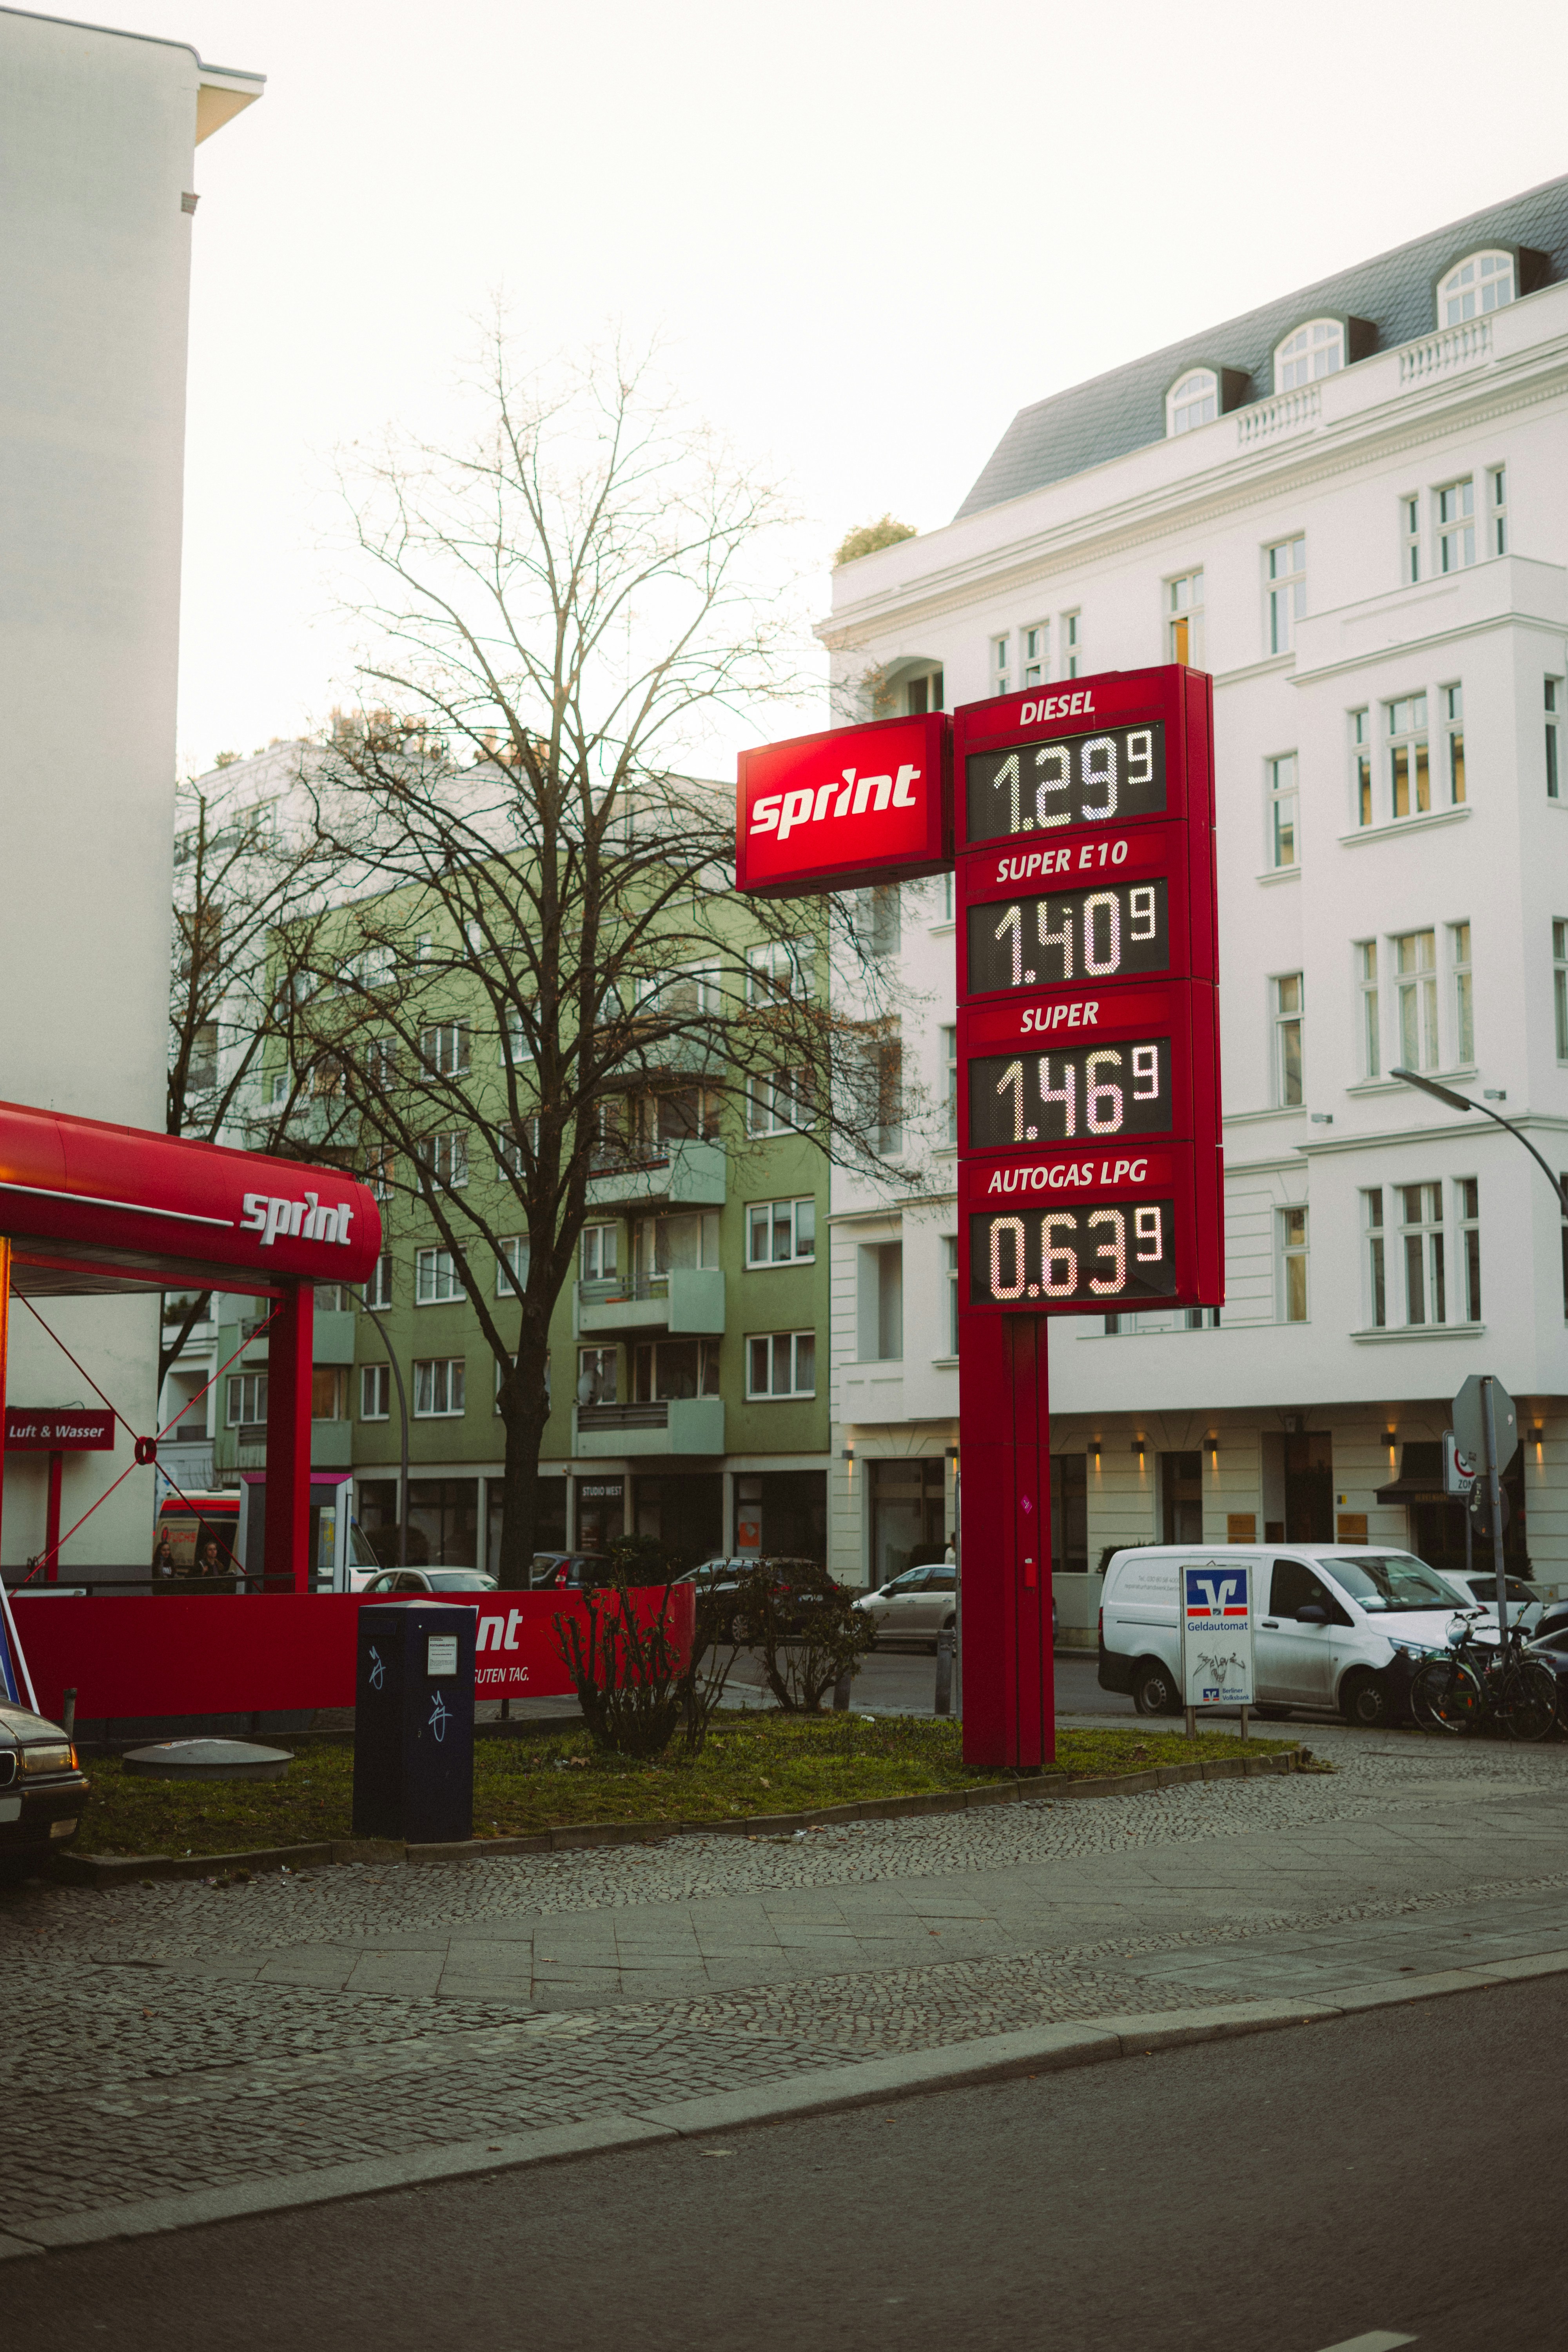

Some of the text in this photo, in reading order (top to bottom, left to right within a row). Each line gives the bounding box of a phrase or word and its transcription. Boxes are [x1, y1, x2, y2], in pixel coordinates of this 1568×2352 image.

[1020, 691, 1095, 725] DIESEL
[750, 764, 921, 840] sprint
[996, 840, 1128, 882] SUPER E10
[1020, 1002, 1099, 1033] SUPER
[987, 1159, 1148, 1193] AUTOGAS LPG
[240, 1192, 354, 1245] sprint
[9, 1425, 105, 1437] Luft & Wasser
[583, 1486, 622, 1496] STUDIO WEST
[1458, 1479, 1473, 1489] ZON
[1188, 1621, 1248, 1631] Geldautomat
[509, 1666, 529, 1682] TAG.
